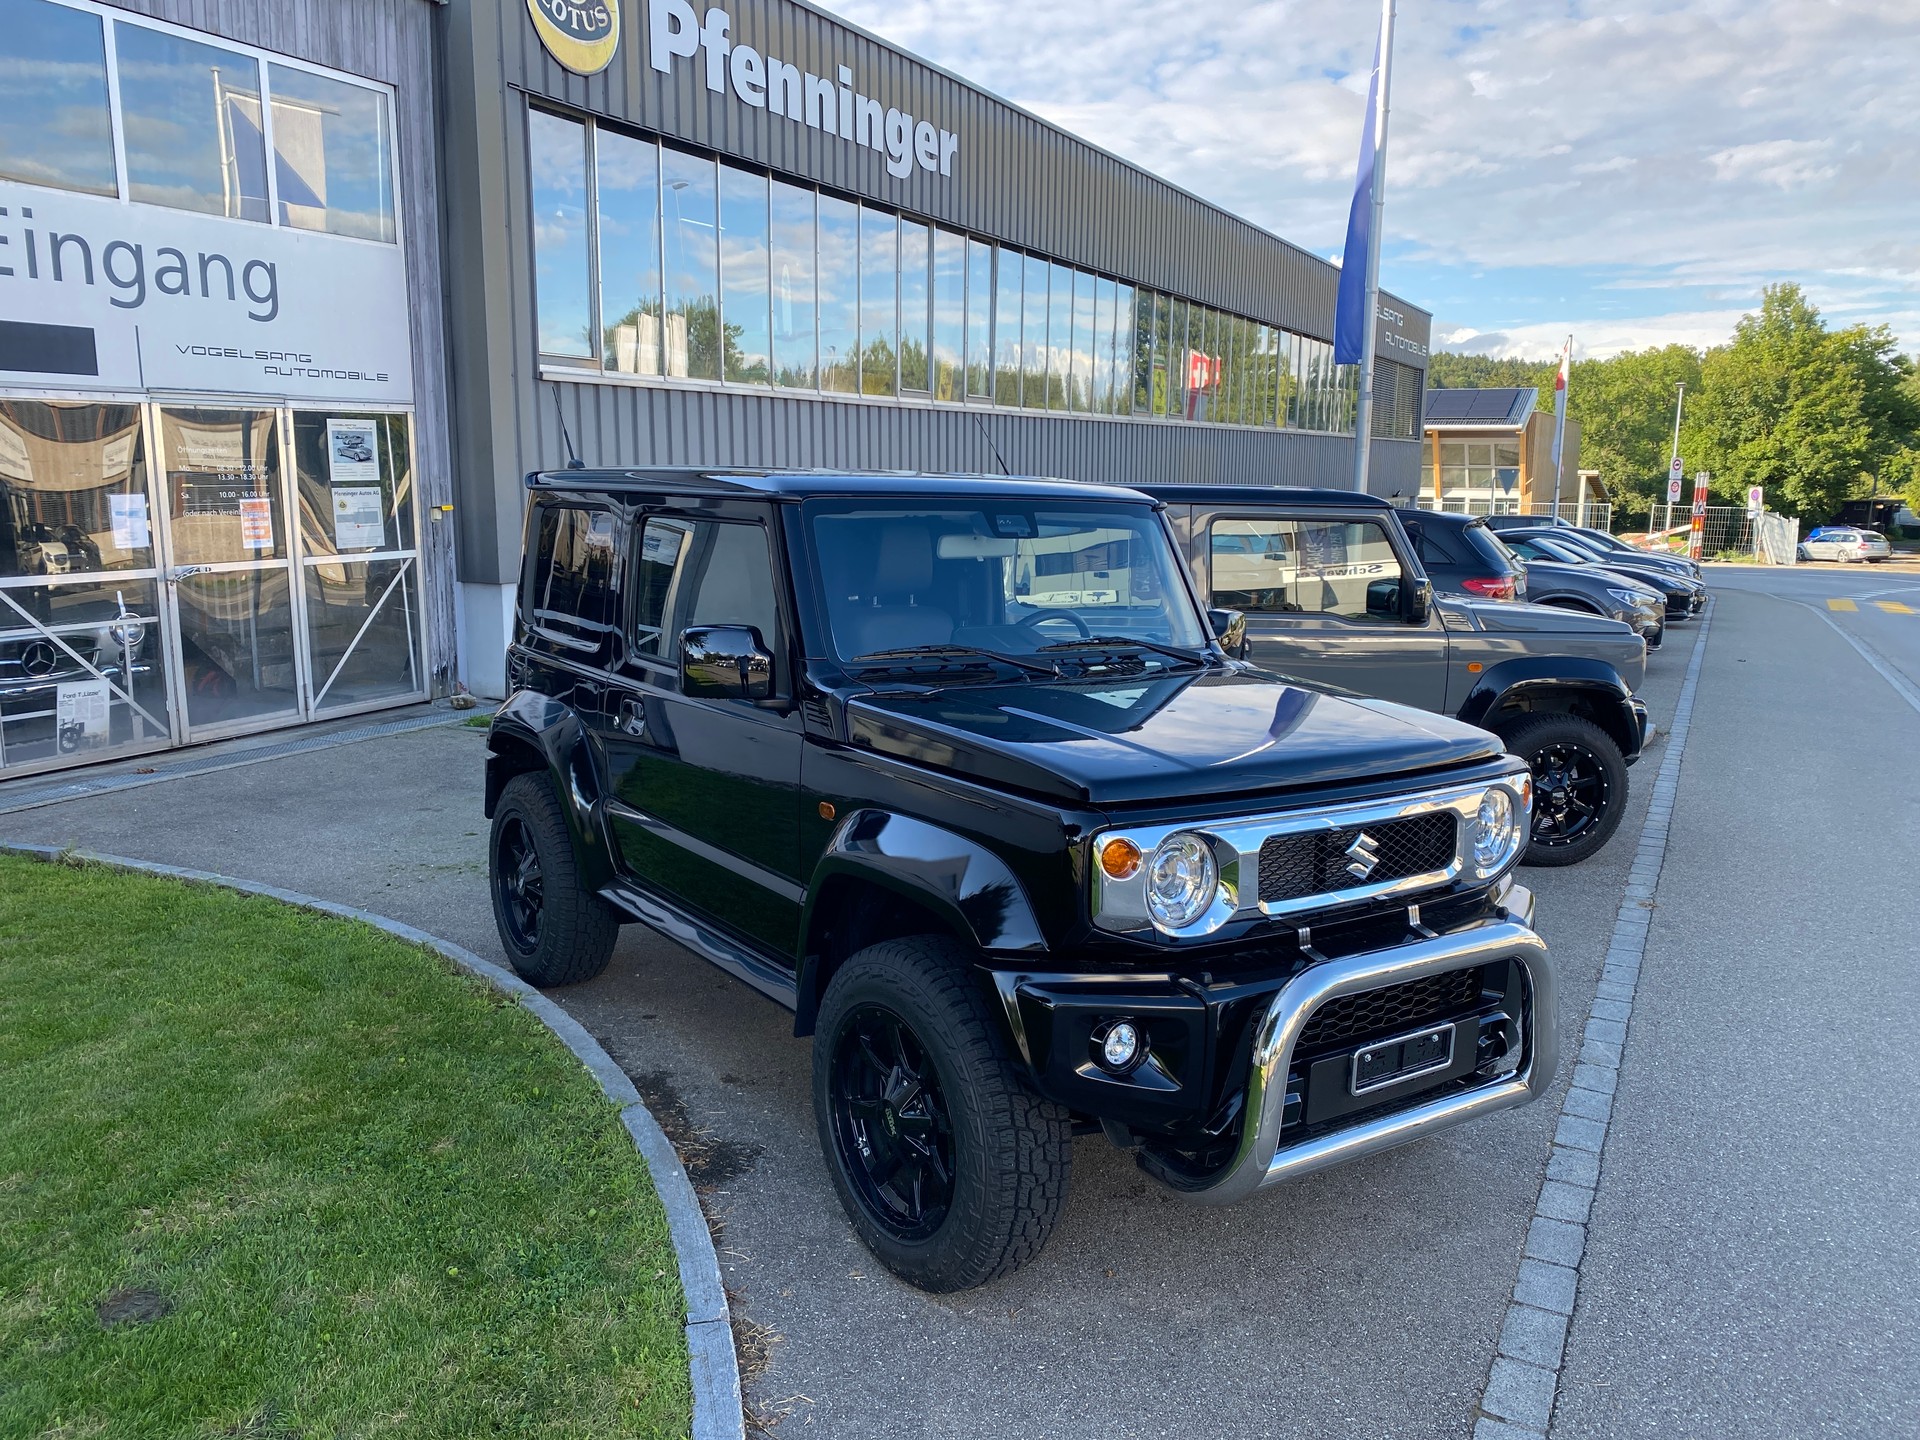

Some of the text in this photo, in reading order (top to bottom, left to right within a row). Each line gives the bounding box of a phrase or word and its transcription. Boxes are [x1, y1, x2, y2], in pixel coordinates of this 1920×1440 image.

[650, 0, 958, 179] Pfenninger
[176, 344, 312, 364] VOGELSANG
[264, 366, 389, 382] AUTOMOBILE
